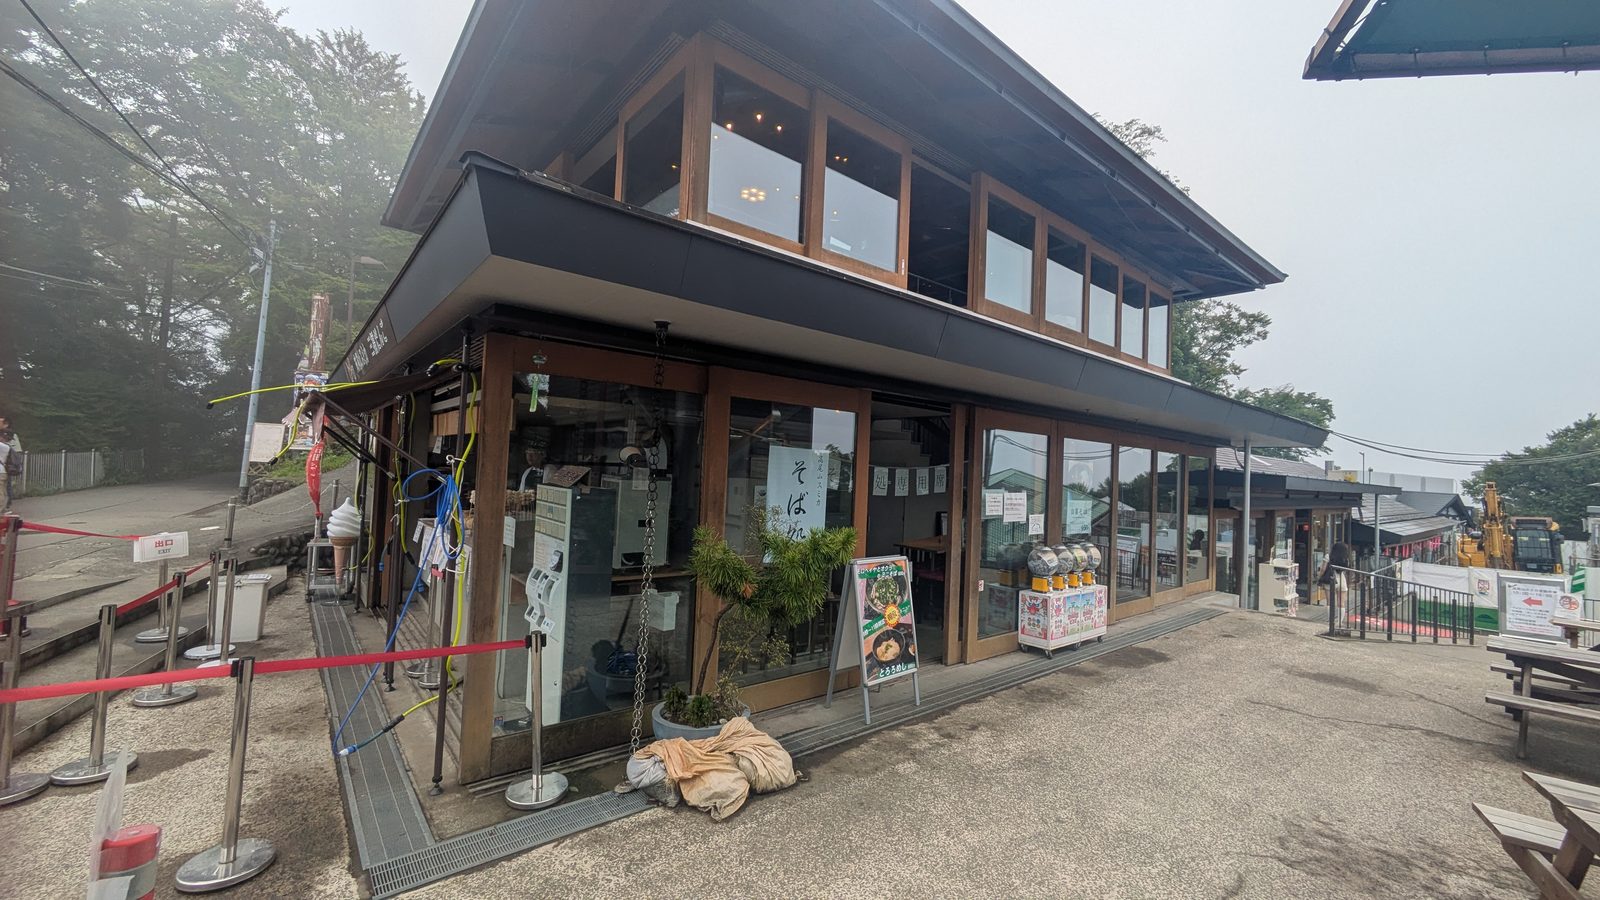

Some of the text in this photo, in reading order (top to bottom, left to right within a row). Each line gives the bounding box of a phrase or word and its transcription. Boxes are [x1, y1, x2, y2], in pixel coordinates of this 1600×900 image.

[154, 539, 174, 548] 出口
[879, 662, 907, 678] とろろめし
